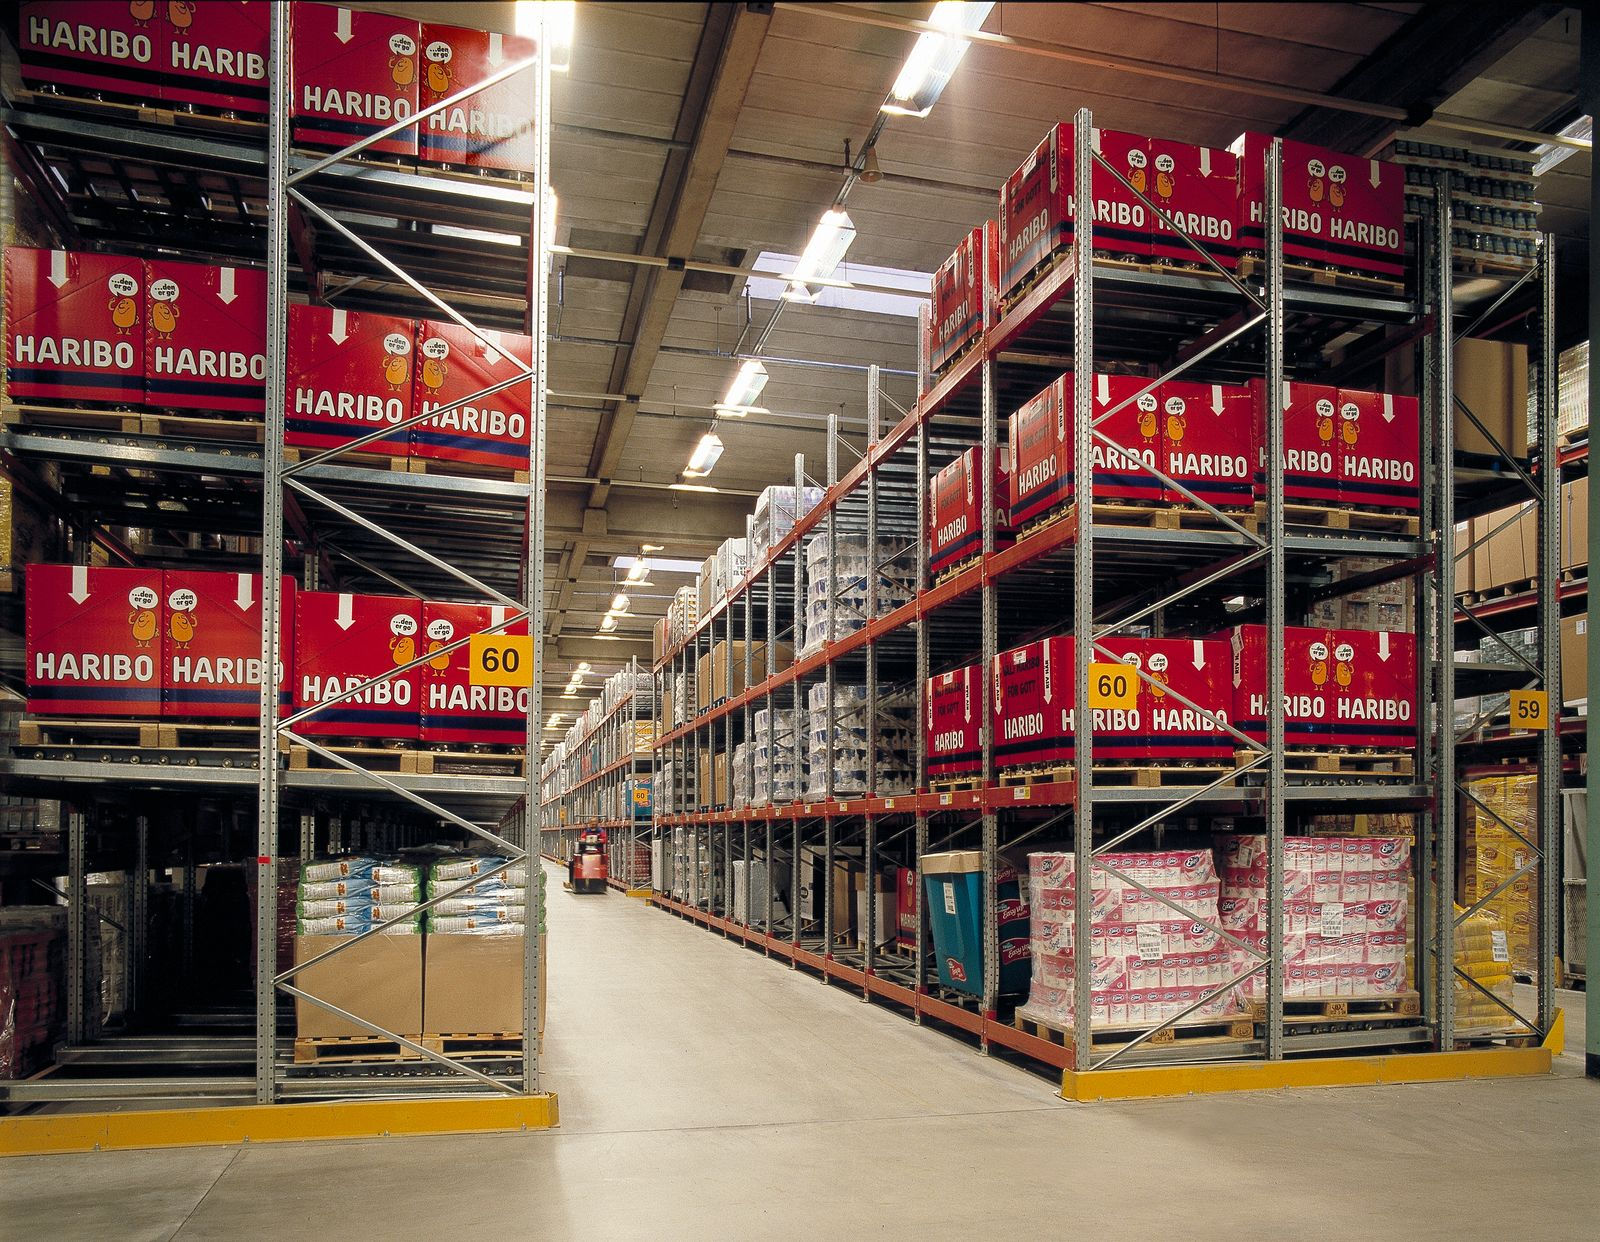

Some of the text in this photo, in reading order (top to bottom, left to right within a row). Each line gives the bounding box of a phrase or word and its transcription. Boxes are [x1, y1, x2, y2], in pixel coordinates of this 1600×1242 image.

[29, 16, 151, 63] HARIBO
[171, 41, 271, 80] HARIB
[303, 85, 412, 123] HARIBO
[1067, 194, 1145, 227] HRIBO
[1158, 207, 1232, 241] HARIBO
[1250, 200, 1322, 234] HRIBO
[1009, 208, 1048, 265] HARIBO
[1330, 217, 1399, 249] HARIBO
[938, 299, 968, 343] HARIBO
[15, 334, 134, 369] HARIBO
[155, 346, 267, 380] HARIBO
[295, 387, 403, 424] HARIBO
[421, 400, 525, 438] HARIBO
[1092, 446, 1155, 471] ARIBO
[1170, 452, 1248, 478] HARIBO
[1259, 446, 1332, 473] HRIBO
[1344, 455, 1414, 482] HARIBO
[1019, 453, 1057, 496] HARIBO
[937, 514, 967, 547] HARIBO
[35, 652, 153, 682] HARIBO
[172, 656, 284, 685] HARIB
[481, 648, 520, 673] 60
[302, 675, 412, 706] HARIBO
[1098, 674, 1127, 698] 60
[1061, 708, 1140, 732] HRIBO
[1153, 708, 1228, 732] HARIBO
[1337, 697, 1410, 721] HARIBO
[1517, 700, 1540, 719] 59
[934, 730, 964, 752] HARIBO
[1004, 713, 1043, 740] HARIBO
[1002, 907, 1016, 919] Easy
[1222, 902, 1236, 911] Edet
[1229, 913, 1245, 925] Soft
[1008, 946, 1021, 959] Easy
